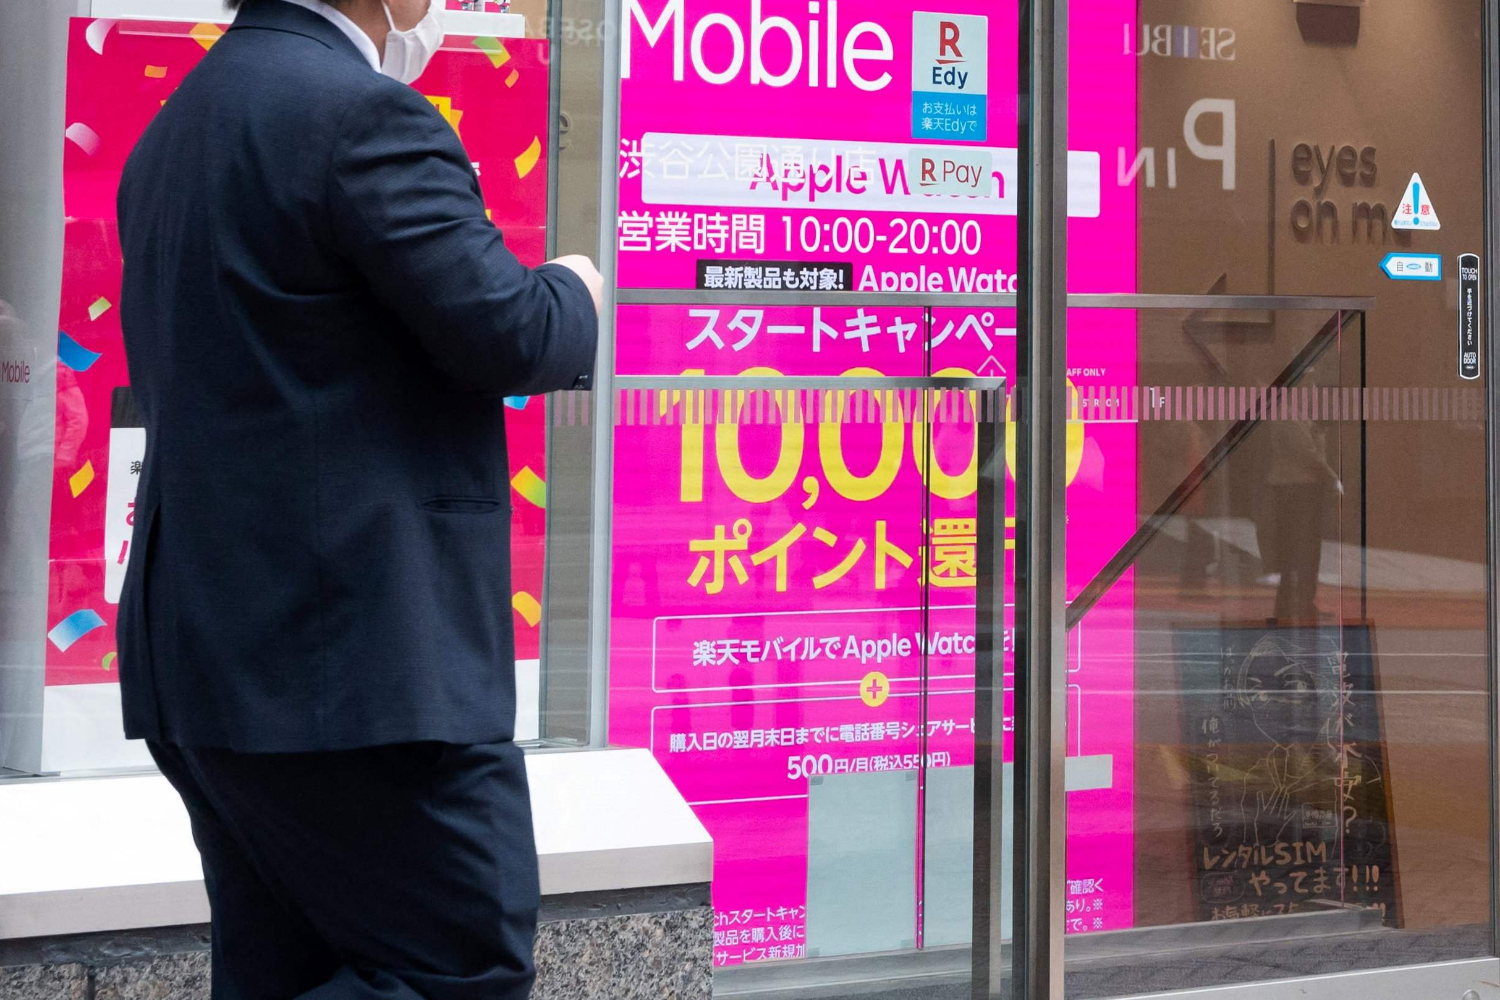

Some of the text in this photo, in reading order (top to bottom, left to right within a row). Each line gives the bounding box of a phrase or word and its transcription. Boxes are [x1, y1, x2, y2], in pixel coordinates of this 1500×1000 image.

[938, 21, 963, 60] R
[931, 66, 969, 89] Edy
[921, 101, 977, 117] お支払いは
[920, 116, 978, 134] 楽天Edyで
[619, 138, 877, 183] 渋谷公園通り店
[1291, 143, 1378, 196] eyes
[943, 161, 983, 187] Pay
[1290, 199, 1339, 242] on
[1402, 203, 1431, 216] 注意
[617, 212, 982, 256] 営業時間 10:00-20:00
[703, 265, 1018, 292] 最新製品も対象! Apple Watc
[1461, 267, 1478, 275] TOUCH
[686, 307, 1017, 353] スタートキャンペー
[1, 360, 30, 384] Mobile
[1066, 368, 1106, 377] AFF ONLY
[130, 460, 143, 475] 楽
[686, 518, 1015, 595] ポイント還
[693, 635, 841, 668] 楽天モバイルで
[843, 632, 911, 663] Apple
[915, 630, 976, 657] Watc
[1203, 840, 1328, 871] レンタルSIM
[1067, 877, 1104, 895] 確認く
[713, 924, 805, 947] 製品を購入後に
